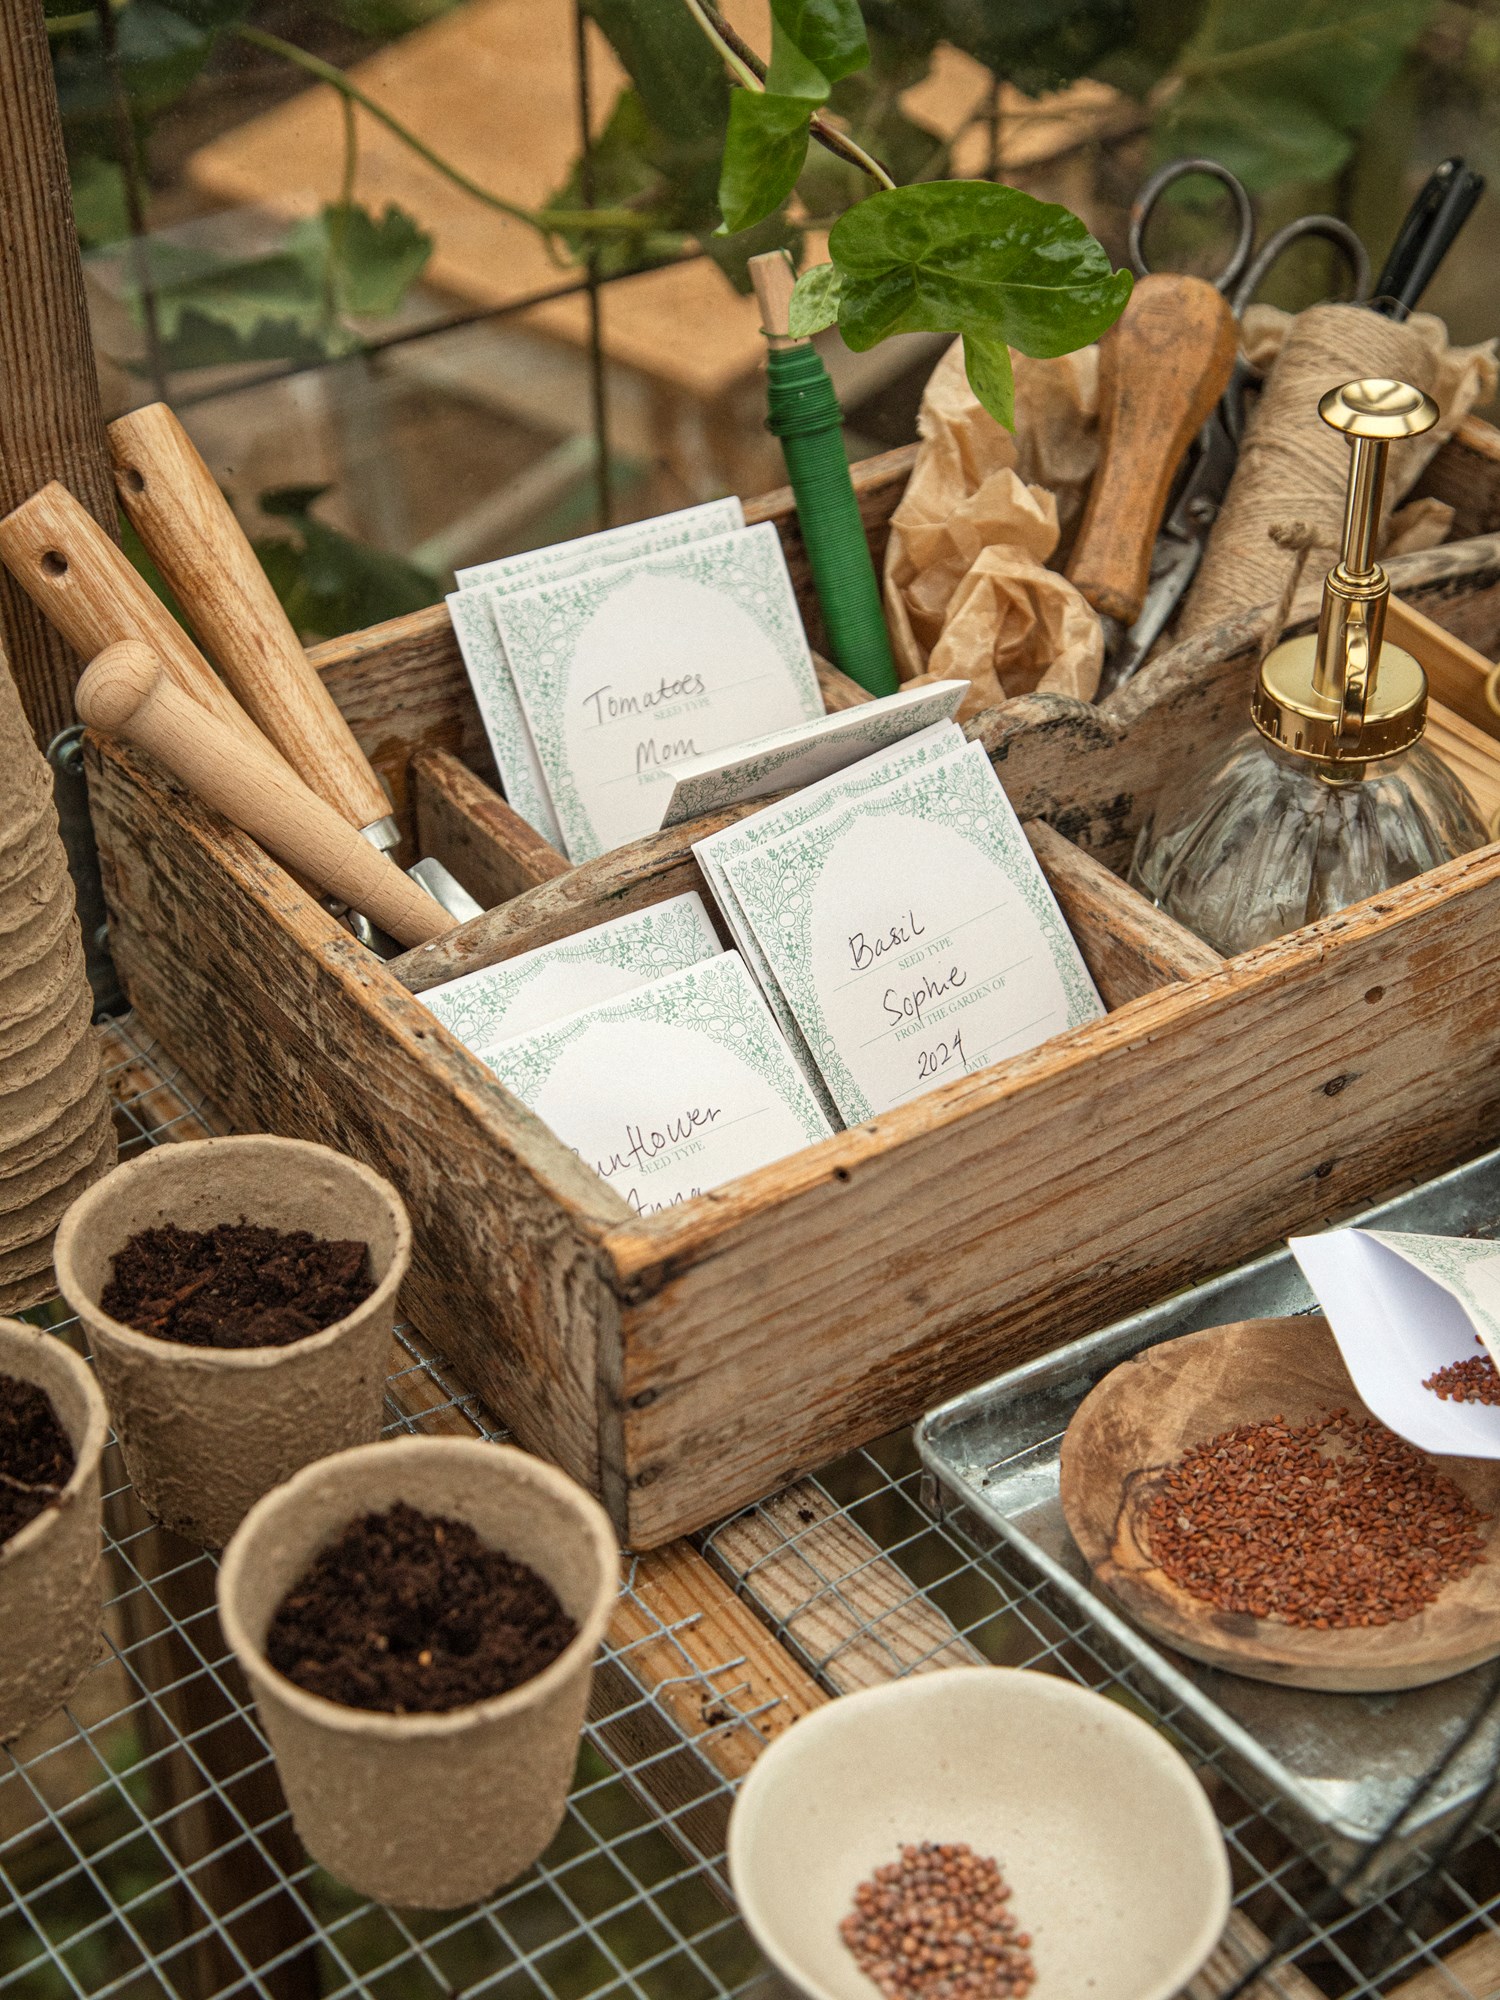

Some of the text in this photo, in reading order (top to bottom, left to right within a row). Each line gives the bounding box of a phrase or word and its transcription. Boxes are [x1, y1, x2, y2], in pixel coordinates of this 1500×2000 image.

[582, 673, 705, 724] Tomatoes
[636, 738, 702, 774] Mom
[848, 909, 925, 971] Basil
[898, 936, 954, 971] SEED TYPE
[883, 961, 967, 1027] Sophie
[894, 976, 1008, 1042] FROM THE GARDEN OF
[917, 1027, 966, 1080] 2024
[963, 1053, 991, 1074] DATE
[571, 1108, 722, 1177] unflower
[639, 1140, 706, 1178] SEED TYPE
